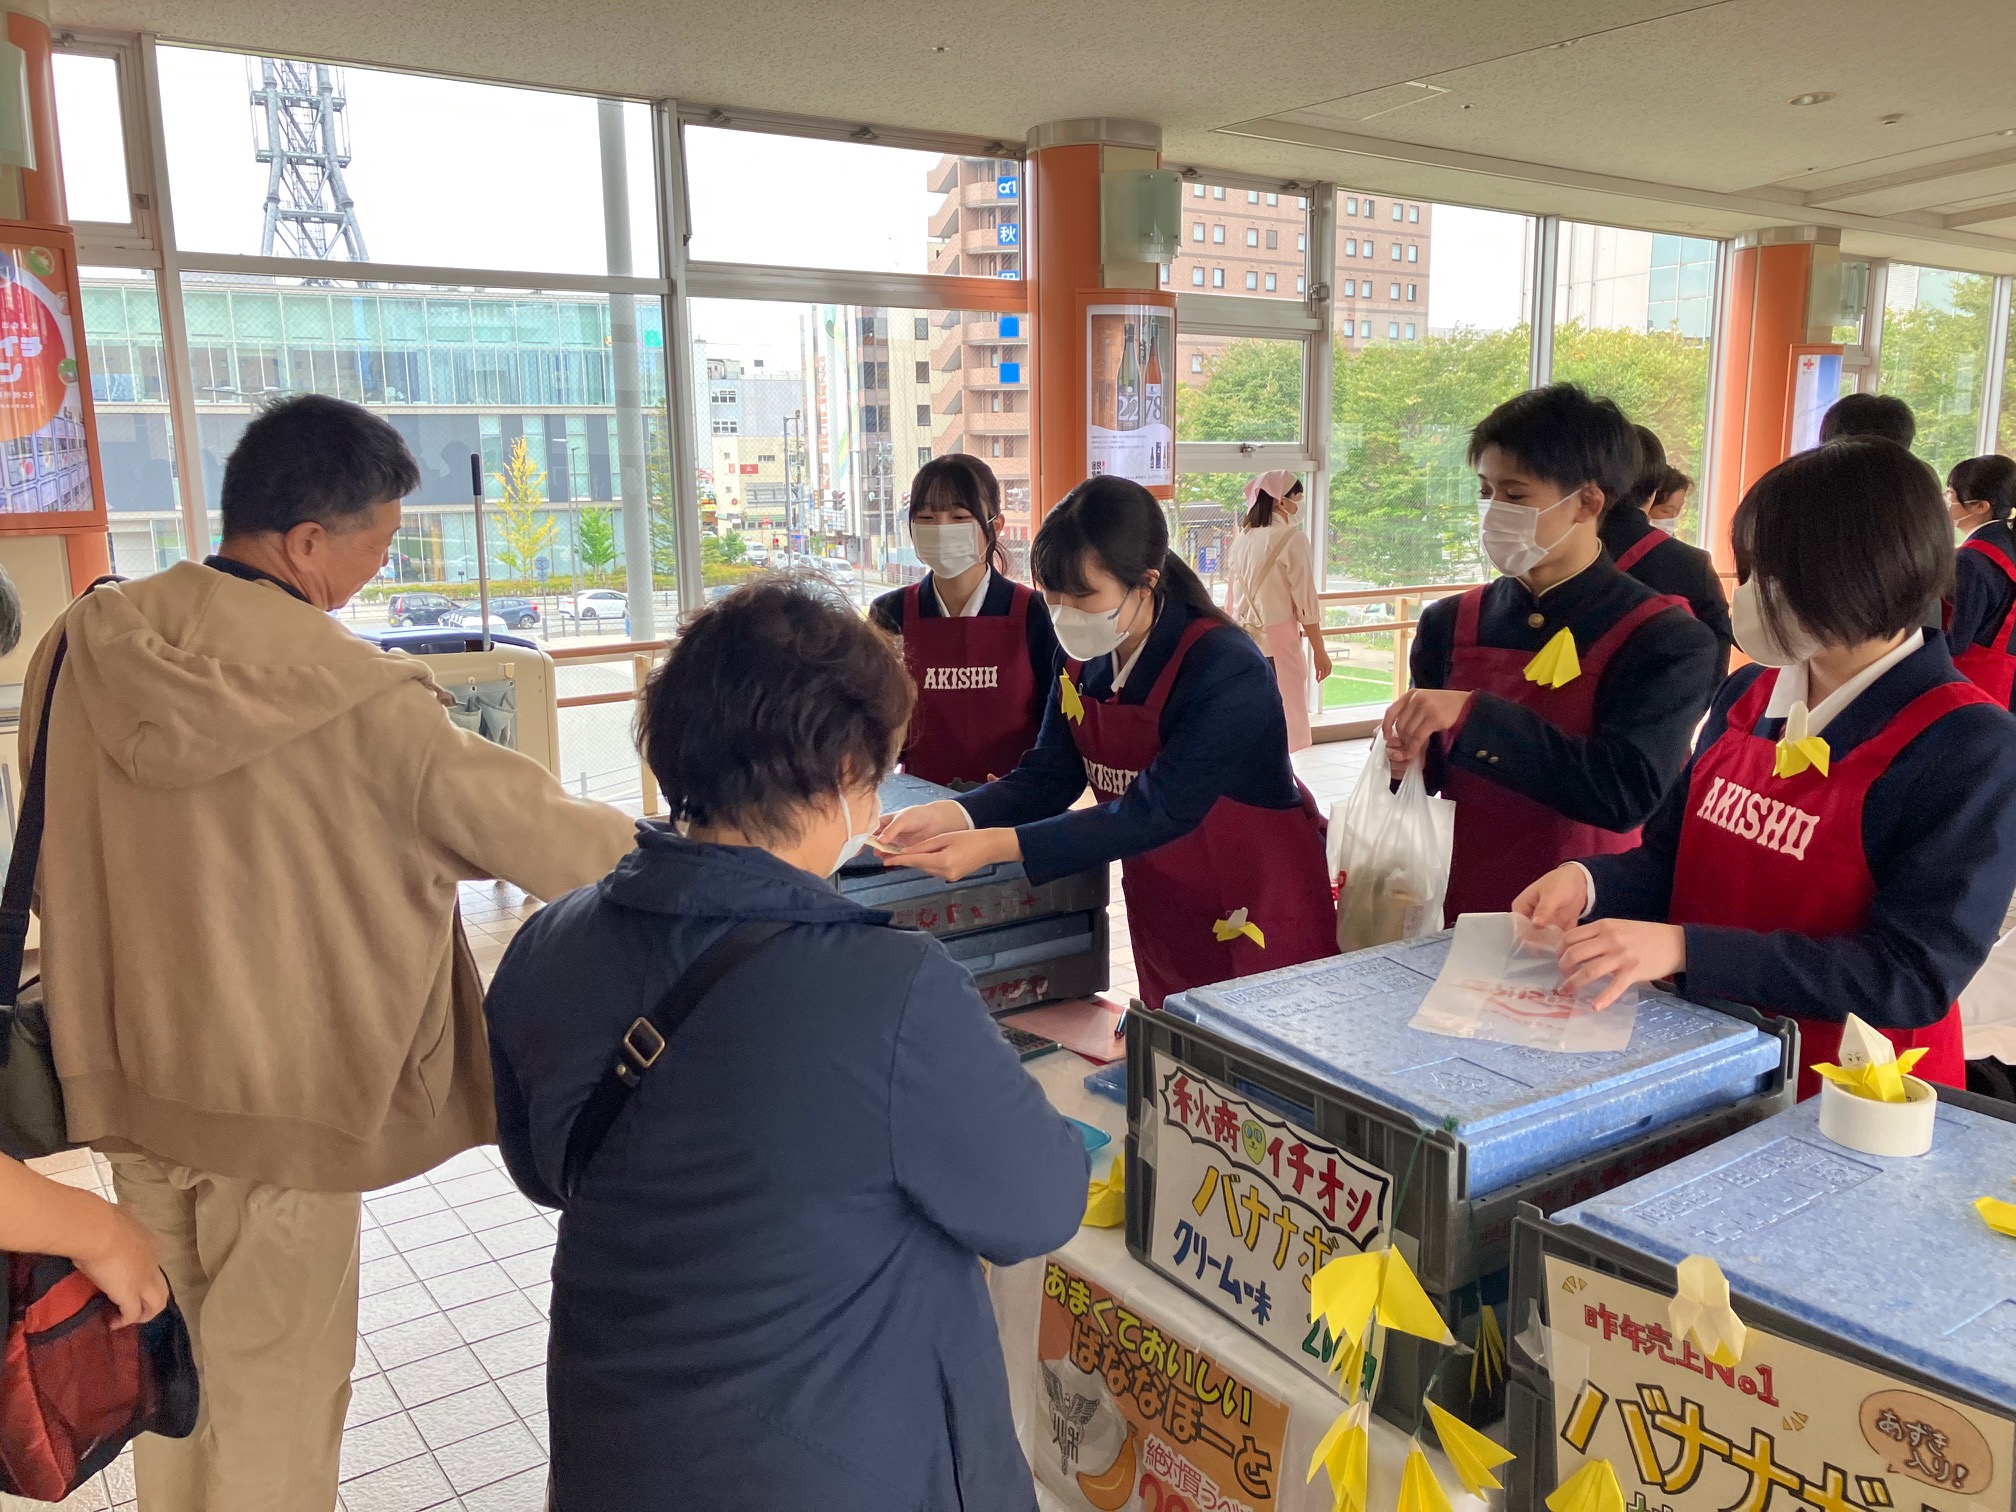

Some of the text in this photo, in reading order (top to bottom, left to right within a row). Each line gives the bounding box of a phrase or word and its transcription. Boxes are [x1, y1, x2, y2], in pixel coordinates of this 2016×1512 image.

[1118, 395, 1139, 421] 22
[1145, 395, 1162, 422] 78
[924, 665, 998, 689] AKISHO
[1697, 776, 1820, 861] AKISHO
[1267, 1137, 1372, 1232] イチオシ
[1173, 1219, 1272, 1326] クリーム味
[1044, 1263, 1253, 1427] あまくておいしい
[1070, 1319, 1272, 1500] ばななぼーと
[1876, 1407, 1949, 1457] あずき
